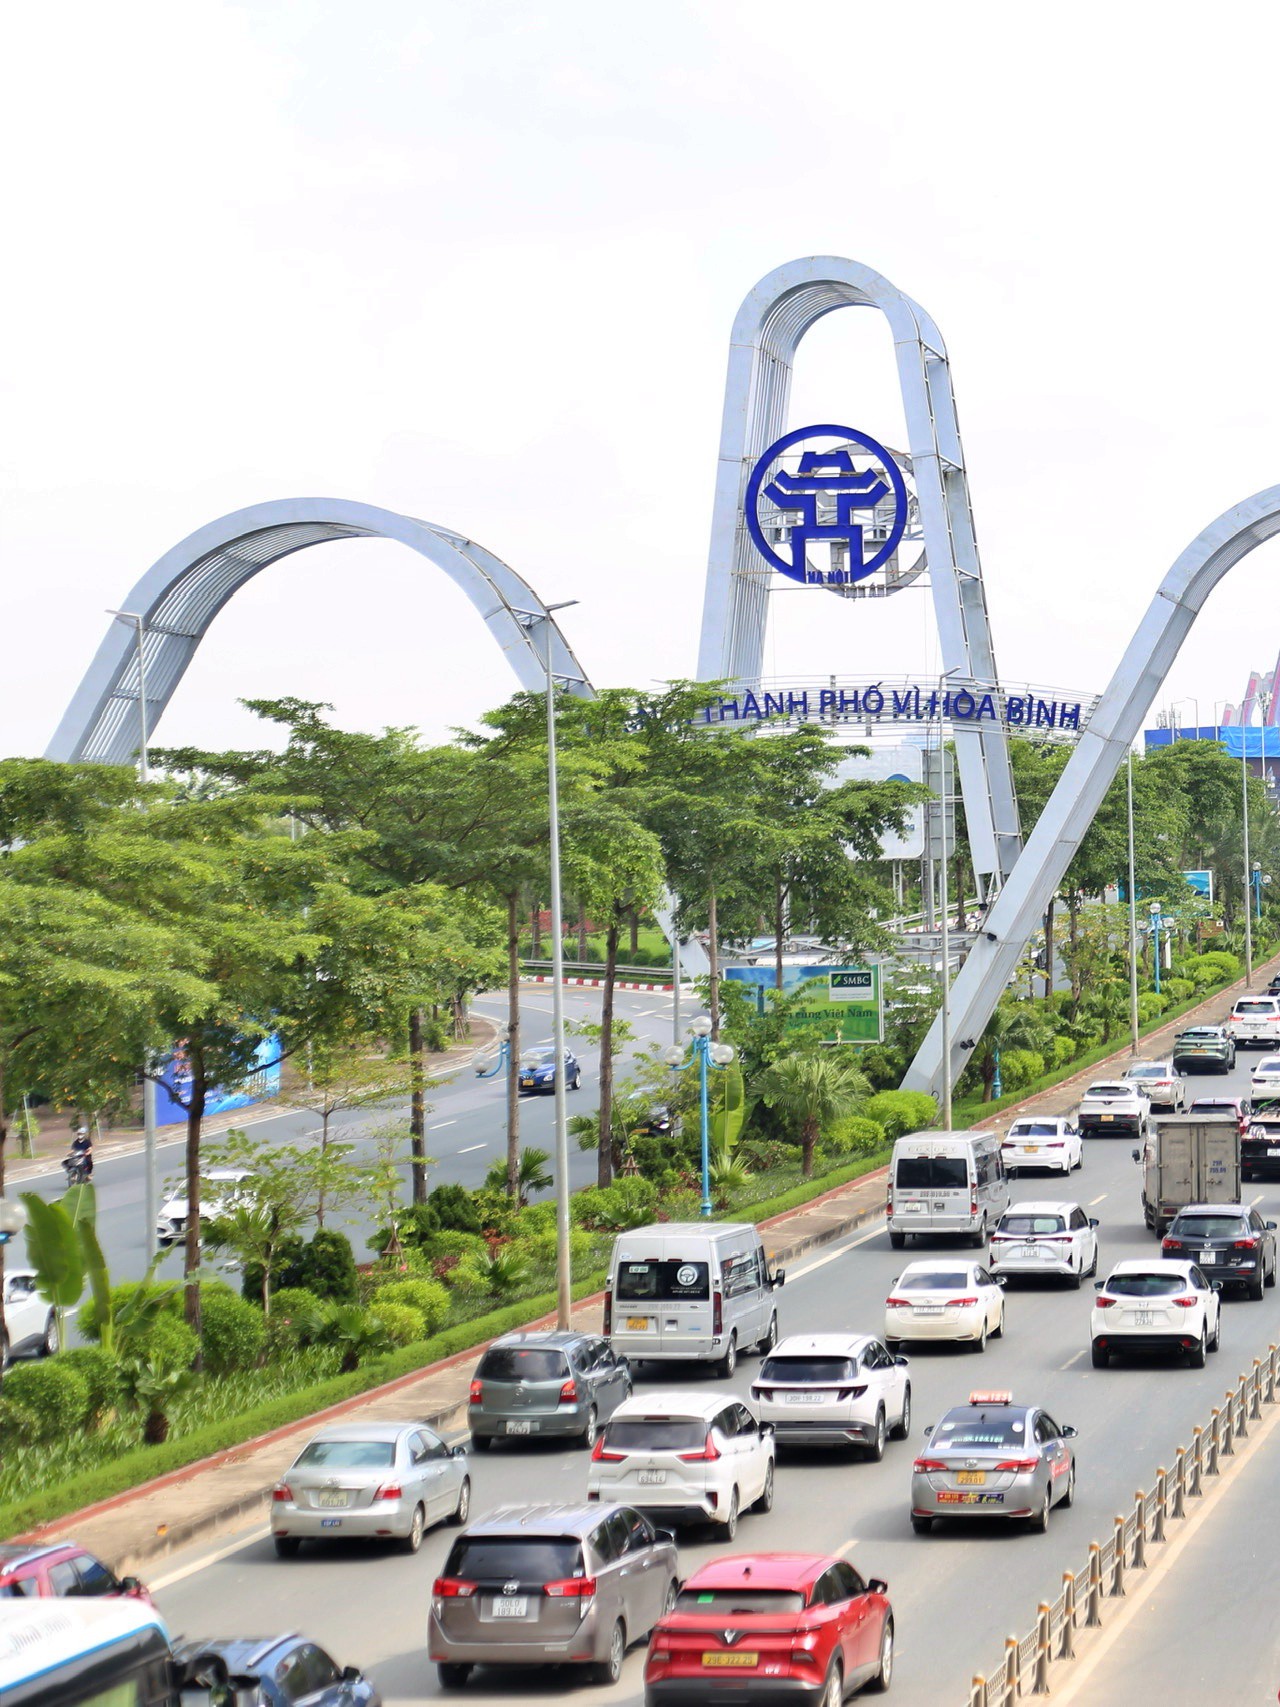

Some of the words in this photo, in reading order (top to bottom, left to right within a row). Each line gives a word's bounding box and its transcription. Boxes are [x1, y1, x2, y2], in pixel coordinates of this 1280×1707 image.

[819, 681, 885, 714] PHỐ
[892, 685, 920, 715] VÌ
[929, 688, 996, 720] HÒA
[1006, 693, 1081, 730] BÌNH
[843, 975, 870, 985] SMBC
[824, 1007, 844, 1018] Việt
[847, 1008, 873, 1018] Nam
